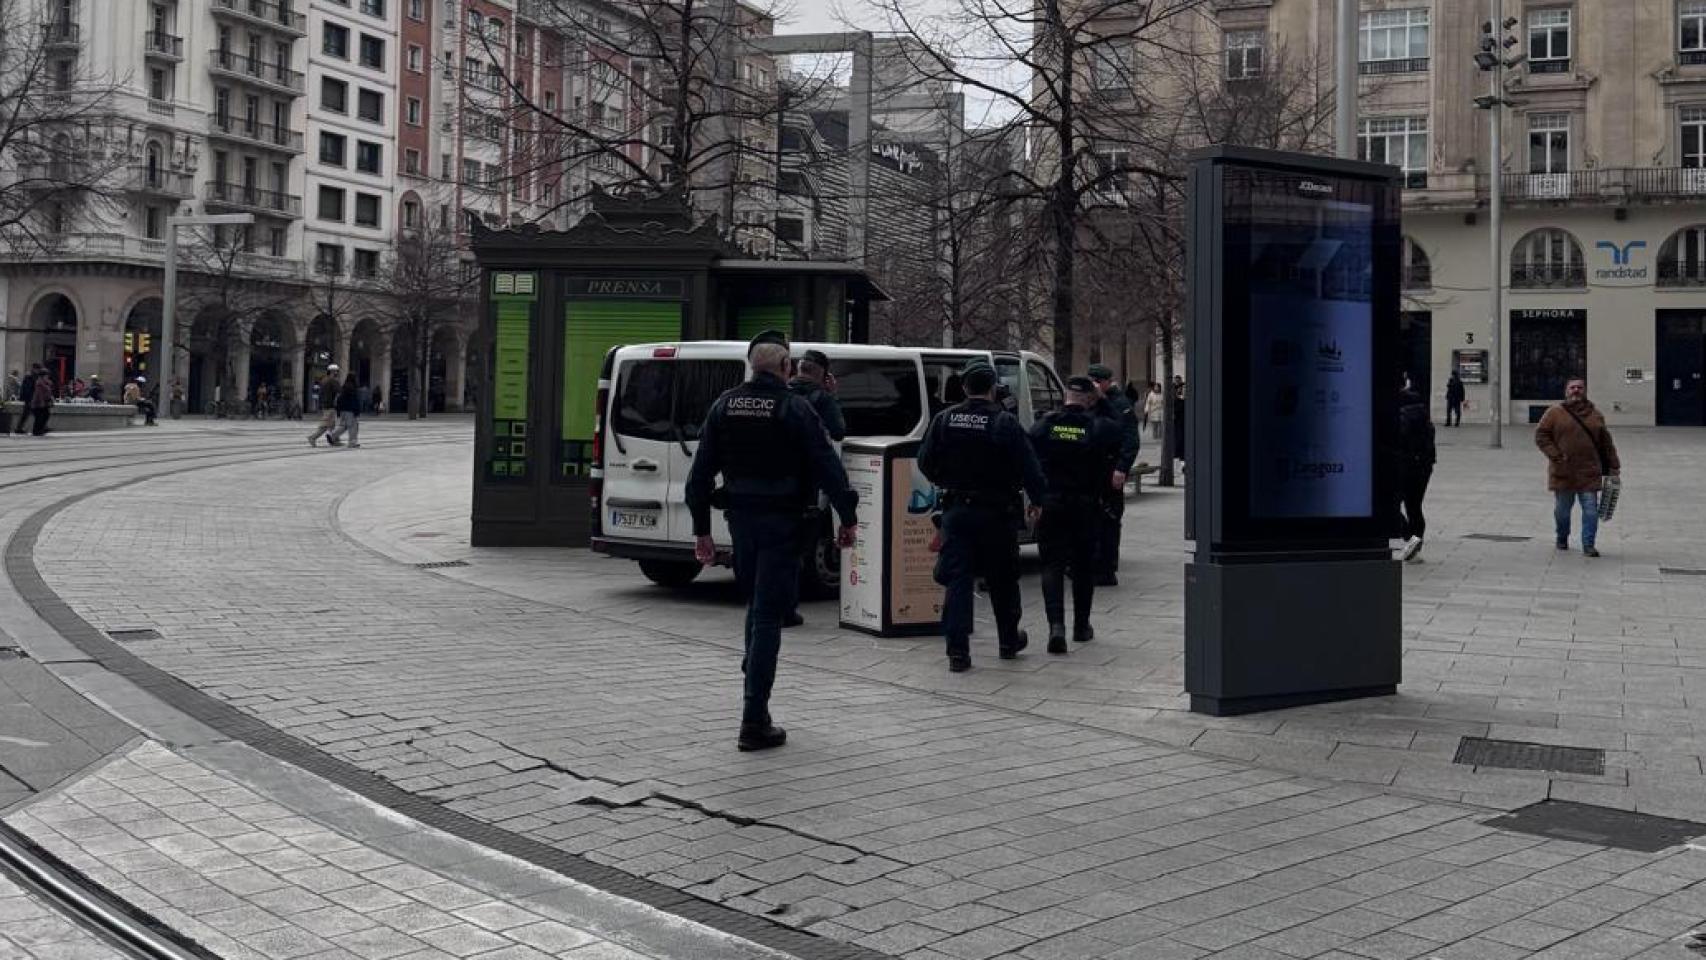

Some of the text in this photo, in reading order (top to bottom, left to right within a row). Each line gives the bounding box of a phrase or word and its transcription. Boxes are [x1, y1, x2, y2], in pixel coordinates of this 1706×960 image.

[1596, 265, 1647, 279] randstad
[587, 279, 662, 294] PRENSA
[1522, 310, 1575, 318] SEPHORA
[728, 397, 775, 409] USECIC
[950, 413, 989, 424] USECIC
